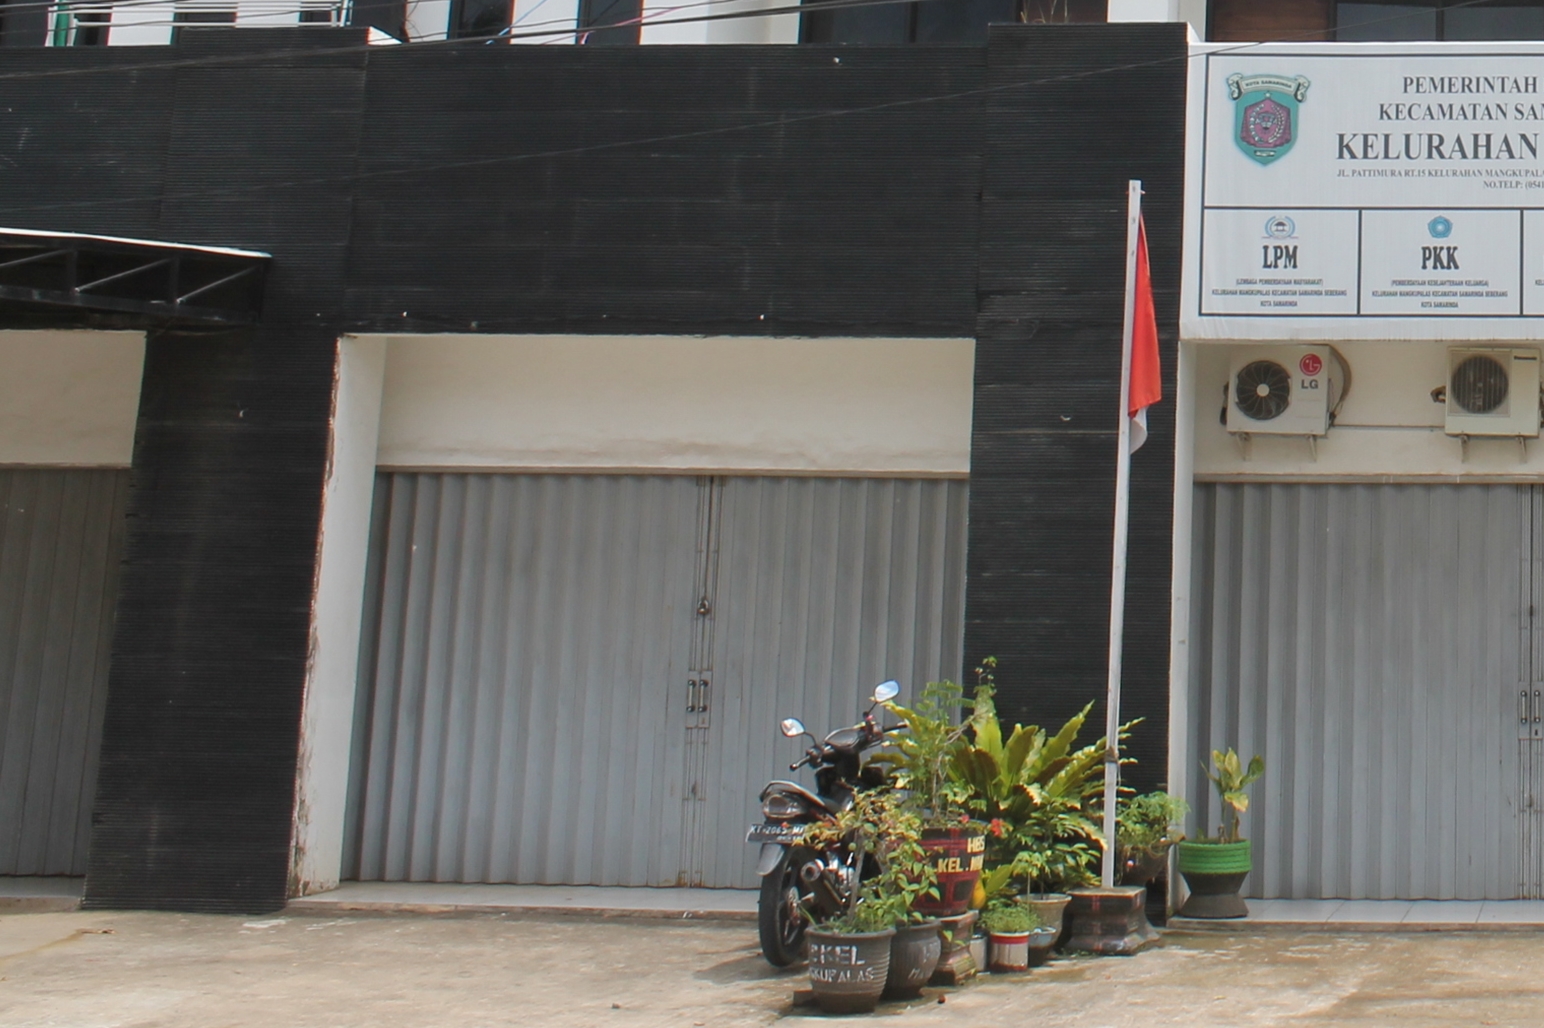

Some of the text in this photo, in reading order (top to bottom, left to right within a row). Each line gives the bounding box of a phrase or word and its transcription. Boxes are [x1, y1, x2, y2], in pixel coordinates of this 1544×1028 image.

[1403, 76, 1537, 95] PEMERINTAH
[1379, 103, 1507, 122] KECAMATAN
[1336, 132, 1539, 161] KELURAHAN
[1351, 169, 1402, 178] PATTIMURA
[1428, 169, 1482, 178] KELURAHAN
[1262, 244, 1298, 269] LPM
[1421, 246, 1459, 270] PKK
[1301, 379, 1319, 389] LG
